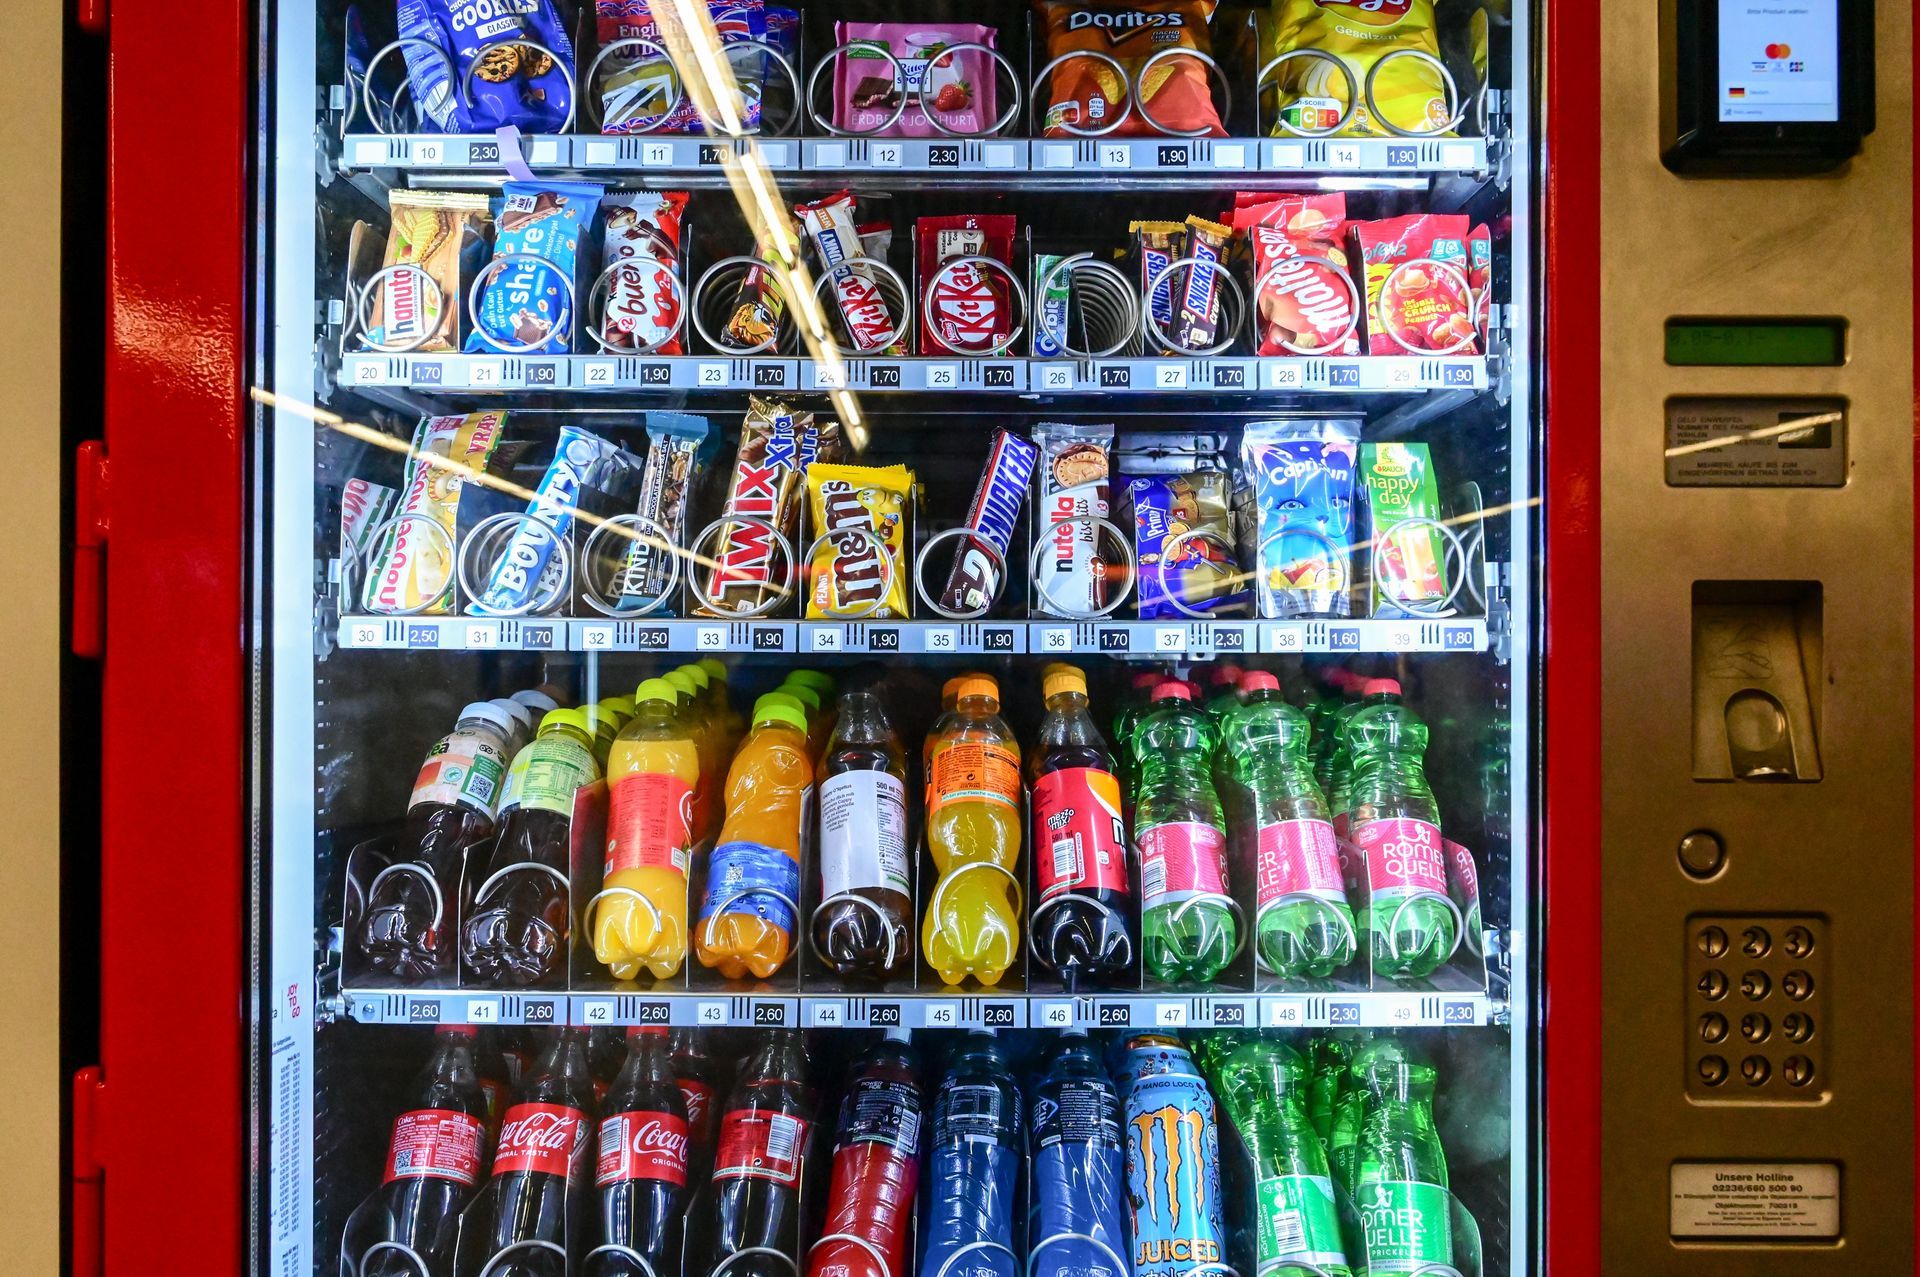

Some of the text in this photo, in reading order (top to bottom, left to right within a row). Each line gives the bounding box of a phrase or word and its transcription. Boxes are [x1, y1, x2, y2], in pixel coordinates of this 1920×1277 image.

[487, 18, 519, 34] CLASSIC
[1069, 11, 1184, 31] Doritos
[1303, 109, 1314, 124] C
[421, 147, 436, 159] 10
[471, 147, 498, 160] 2,30
[651, 149, 664, 161] 11
[703, 147, 729, 163] 1,70
[880, 149, 895, 162] 12
[931, 150, 957, 163] 2,30
[1108, 150, 1124, 163] 13
[1161, 150, 1186, 163] 1,90
[1338, 151, 1353, 163] 14
[1390, 151, 1415, 162] 1,90
[505, 228, 544, 305] share
[617, 245, 648, 316] bueno
[838, 277, 894, 336] KitKat
[937, 261, 996, 342] KitKat
[485, 291, 498, 329] Dein Kauf
[496, 289, 507, 328] tut Gutes!
[1404, 303, 1452, 318] CRUNCH
[1180, 309, 1196, 325] 2
[361, 367, 378, 379] 20
[415, 367, 440, 380] 1,70
[476, 368, 491, 381] 21
[528, 368, 553, 382] 1,90
[590, 368, 607, 381] 22
[643, 369, 668, 381] 1,90
[705, 369, 722, 382] 23
[758, 370, 783, 383] 1,70
[873, 371, 898, 383] 1,70
[934, 370, 951, 383] 25
[987, 371, 1012, 383] 1,70
[1049, 372, 1066, 385] 26
[1103, 371, 1128, 384] 1,70
[1164, 371, 1181, 383] 27
[1217, 370, 1242, 384] 1,70
[1279, 370, 1296, 383] 28
[1332, 370, 1358, 383] 1,70
[1393, 369, 1410, 382] 29
[1446, 369, 1471, 383] 1,90
[466, 414, 498, 456] WRAP
[763, 414, 795, 473] Xtra
[1381, 464, 1406, 474] RAUCH
[648, 439, 669, 518] CHOCOLATE SALT
[1366, 473, 1419, 496] happy
[976, 433, 1037, 557] SNICKERS
[1379, 490, 1412, 510] day
[500, 461, 580, 593] BOUNTY
[710, 462, 777, 600] TWIX
[1049, 496, 1076, 573] nutella
[622, 540, 650, 596] KIND
[815, 572, 830, 605] PEANUT
[358, 629, 375, 643] 30
[410, 630, 437, 643] 2,50
[473, 631, 488, 644] 31
[526, 631, 551, 645] 1,70
[588, 632, 605, 645] 32
[641, 632, 667, 645] 2,50
[703, 632, 720, 646] 33
[756, 633, 781, 646] 1,90
[818, 634, 835, 647] 34
[872, 634, 896, 647] 1,90
[933, 634, 950, 647] 35
[986, 634, 1011, 647] 1,90
[1049, 634, 1065, 647] 36
[1102, 634, 1127, 647] 1,70
[1163, 634, 1180, 647] 37
[1216, 634, 1242, 647] 2,30
[1279, 634, 1296, 647] 38
[1332, 633, 1358, 646] 1,60
[1394, 633, 1411, 646] 39
[1446, 632, 1472, 646] 1,80
[876, 781, 896, 792] 500 ml
[1047, 808, 1075, 827] mezzo
[1051, 815, 1071, 831] mix
[1261, 886, 1282, 900] STILL
[1701, 928, 1800, 954] 1 2 3
[287, 983, 299, 997] JOY
[1697, 973, 1715, 994] 4
[289, 995, 298, 1007] TO
[291, 1006, 301, 1018] GO
[412, 1005, 438, 1018] 2,60
[473, 1006, 489, 1018] 41
[526, 1006, 552, 1019] 2,60
[589, 1007, 606, 1020] 42
[642, 1007, 668, 1020] 2,60
[704, 1007, 721, 1020] 43
[756, 1008, 782, 1021] 2,60
[819, 1009, 836, 1022] 44
[872, 1009, 897, 1022] 2,60
[933, 1009, 951, 1022] 45
[986, 1010, 1012, 1021] 2,60
[1049, 1009, 1066, 1022] 46
[1102, 1009, 1128, 1022] 2,60
[1164, 1009, 1181, 1022] 47
[1216, 1008, 1242, 1020] 2,30
[1279, 1008, 1296, 1021] 48
[1332, 1008, 1358, 1022] 2,30
[1394, 1007, 1411, 1020] 49
[1446, 1007, 1472, 1021] 2,30
[1701, 1015, 1715, 1038] 7
[1783, 1015, 1799, 1038] 9
[1741, 1057, 1758, 1079] 0
[1141, 1080, 1195, 1091] MANGO LOCO
[452, 1114, 463, 1122] 500
[521, 1149, 549, 1158] TASTE
[1715, 1172, 1794, 1182] Unsere Hotline
[1768, 1184, 1787, 1193] 500
[1790, 1184, 1803, 1193] 90
[1136, 1237, 1221, 1265] JUICED
